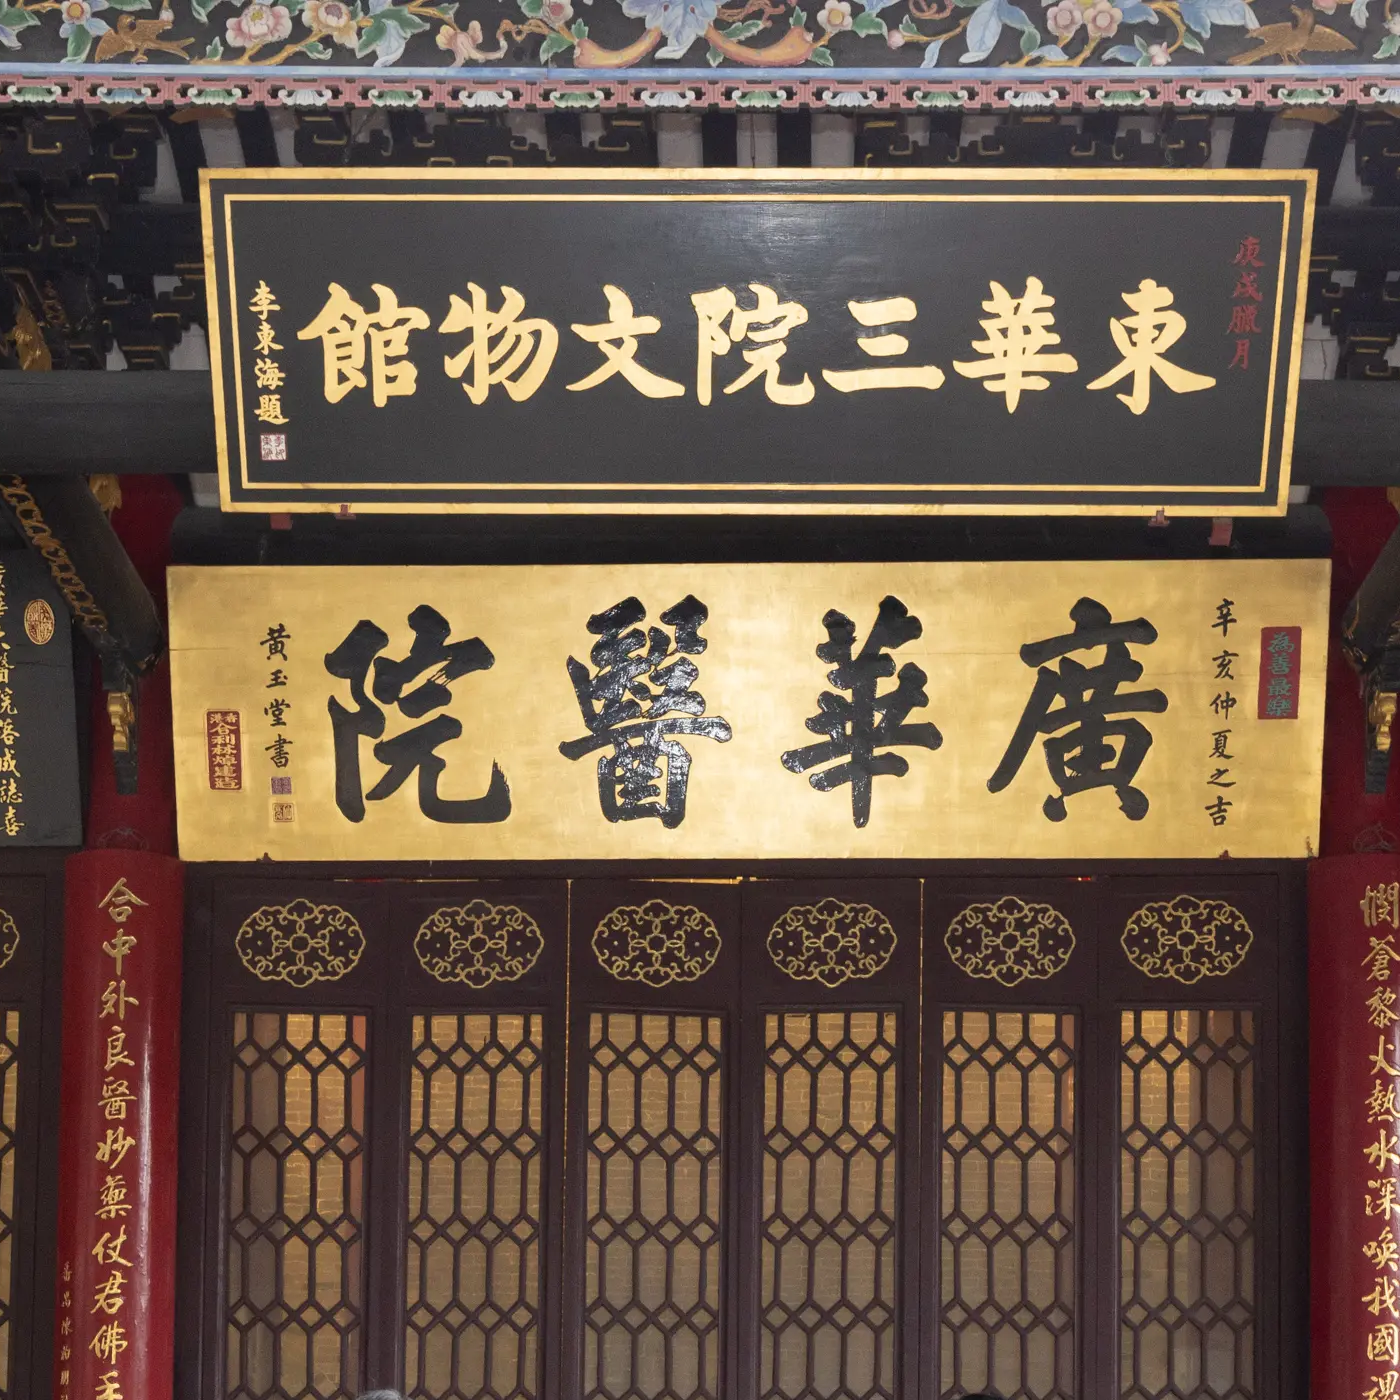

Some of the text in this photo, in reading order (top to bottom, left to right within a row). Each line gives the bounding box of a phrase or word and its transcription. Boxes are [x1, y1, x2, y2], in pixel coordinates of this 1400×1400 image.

[248, 280, 290, 424] 李東海題
[297, 275, 1217, 416] 東華三院文物館
[260, 623, 293, 768] 黃玉堂書
[325, 595, 1169, 827] 廣華醫院
